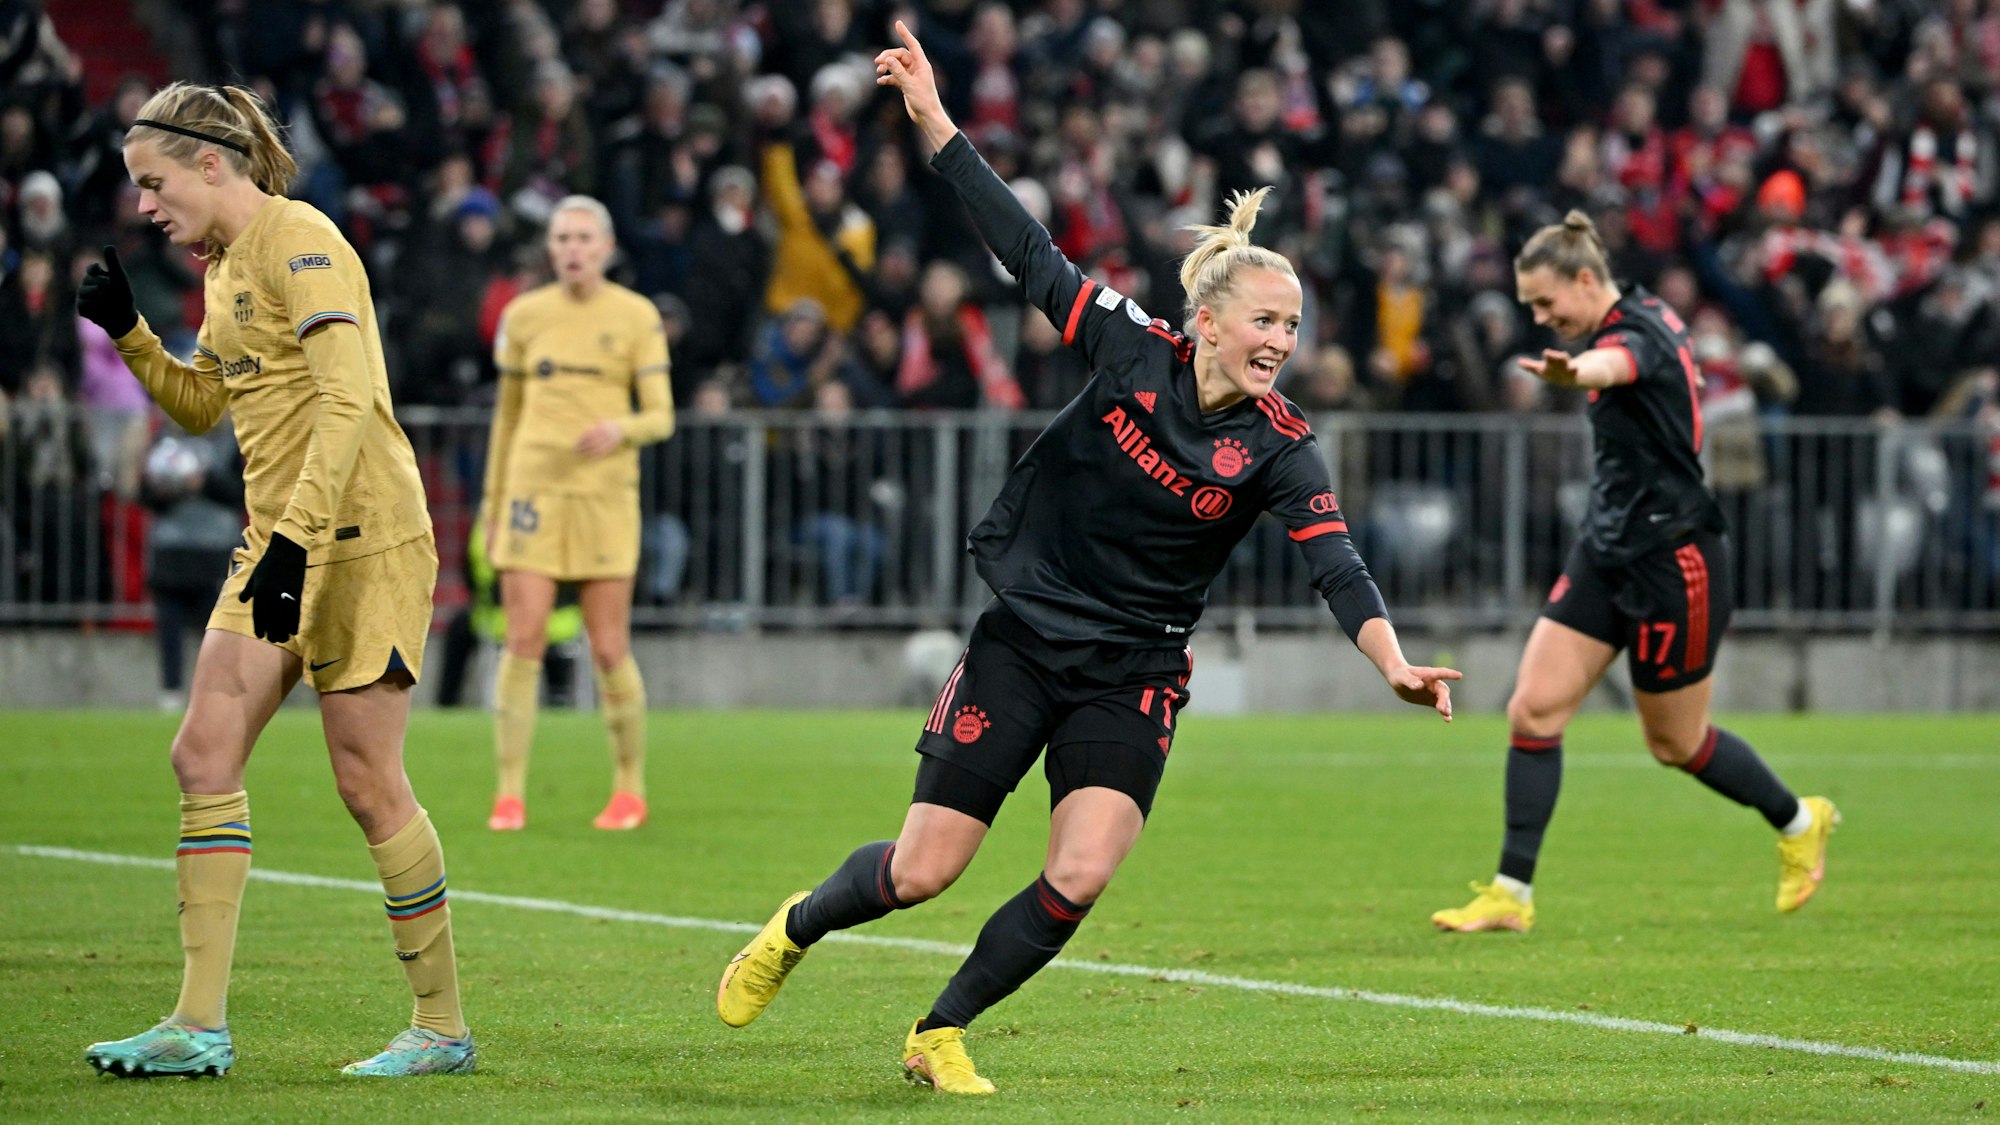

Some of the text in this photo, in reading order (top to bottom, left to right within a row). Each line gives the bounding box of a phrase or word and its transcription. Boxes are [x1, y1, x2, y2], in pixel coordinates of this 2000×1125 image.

[289, 256, 331, 272] BIMBO
[224, 355, 261, 378] Spotify
[1101, 405, 1193, 497] Allianz
[1638, 621, 1677, 665] 17
